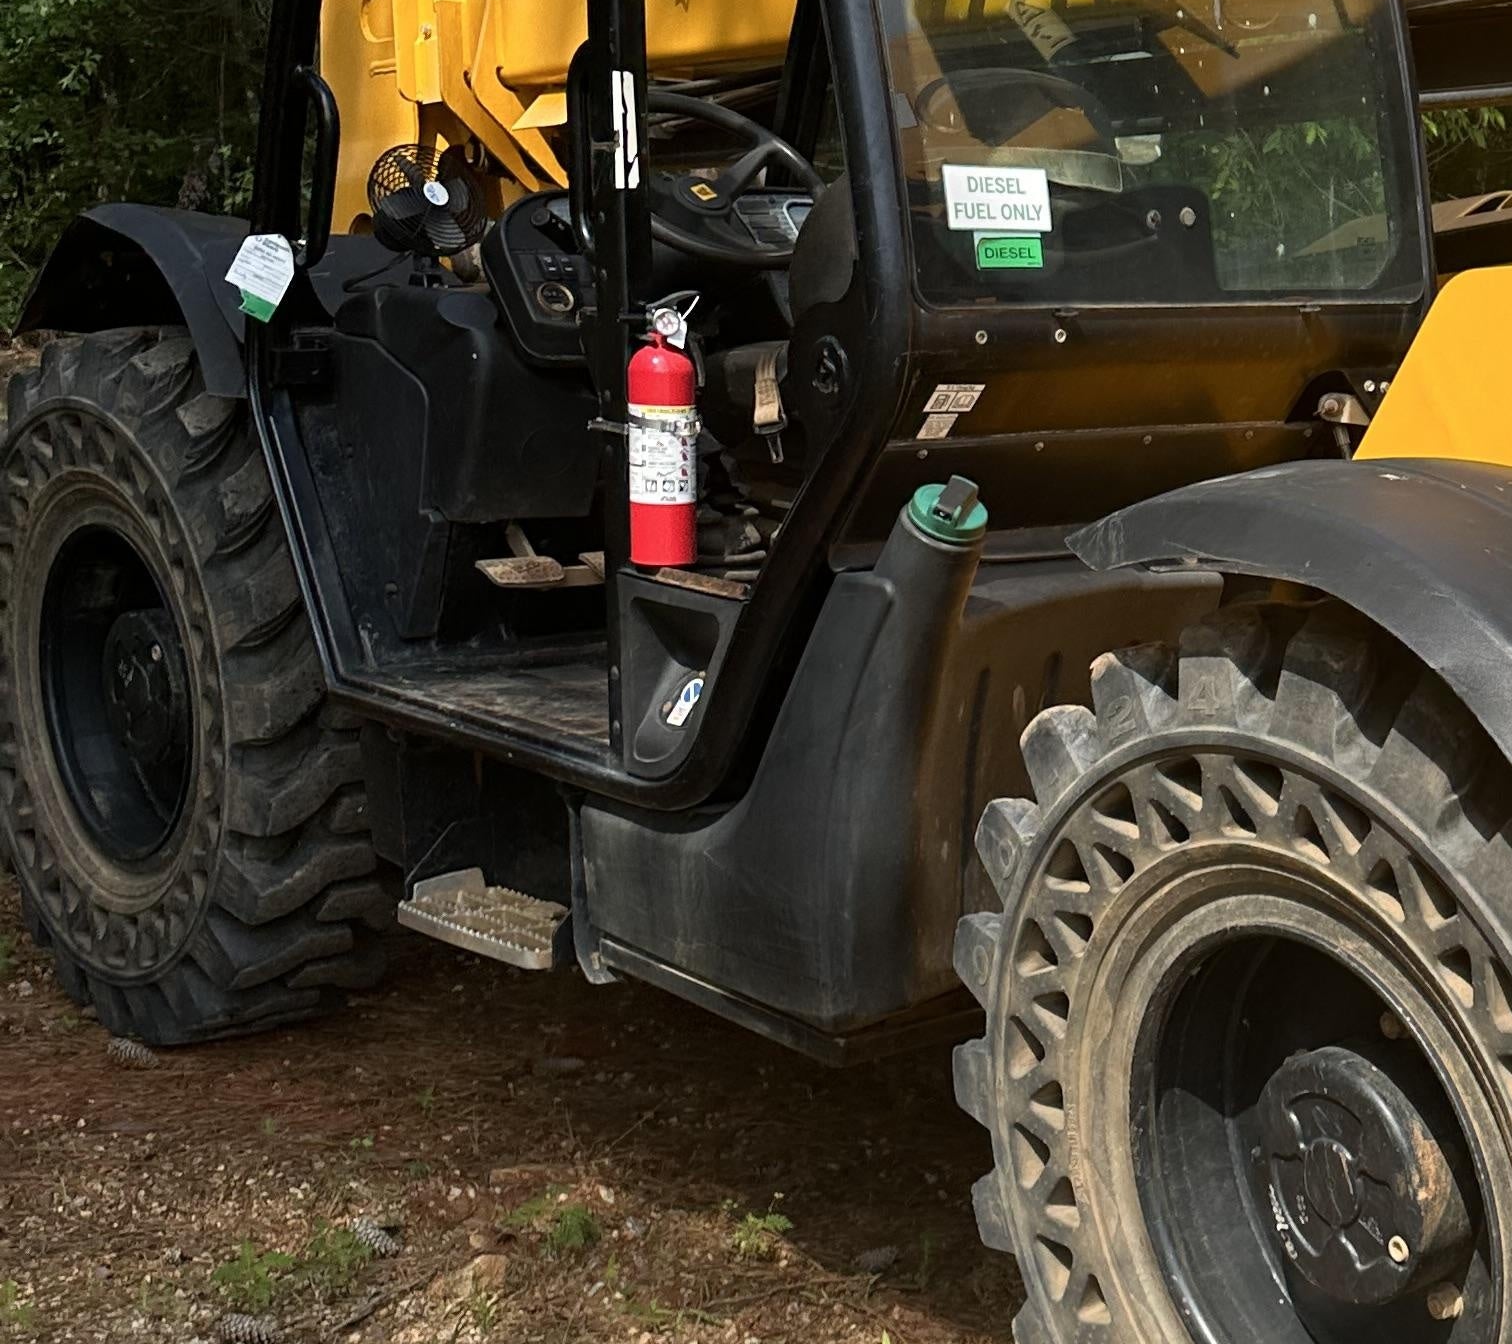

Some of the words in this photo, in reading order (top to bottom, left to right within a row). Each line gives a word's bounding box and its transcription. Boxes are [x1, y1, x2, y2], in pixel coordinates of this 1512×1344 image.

[966, 175, 1027, 195] DIESEL
[953, 202, 997, 220] FUEL
[1000, 203, 1043, 221] ONLY
[984, 246, 1037, 259] DIESEL
